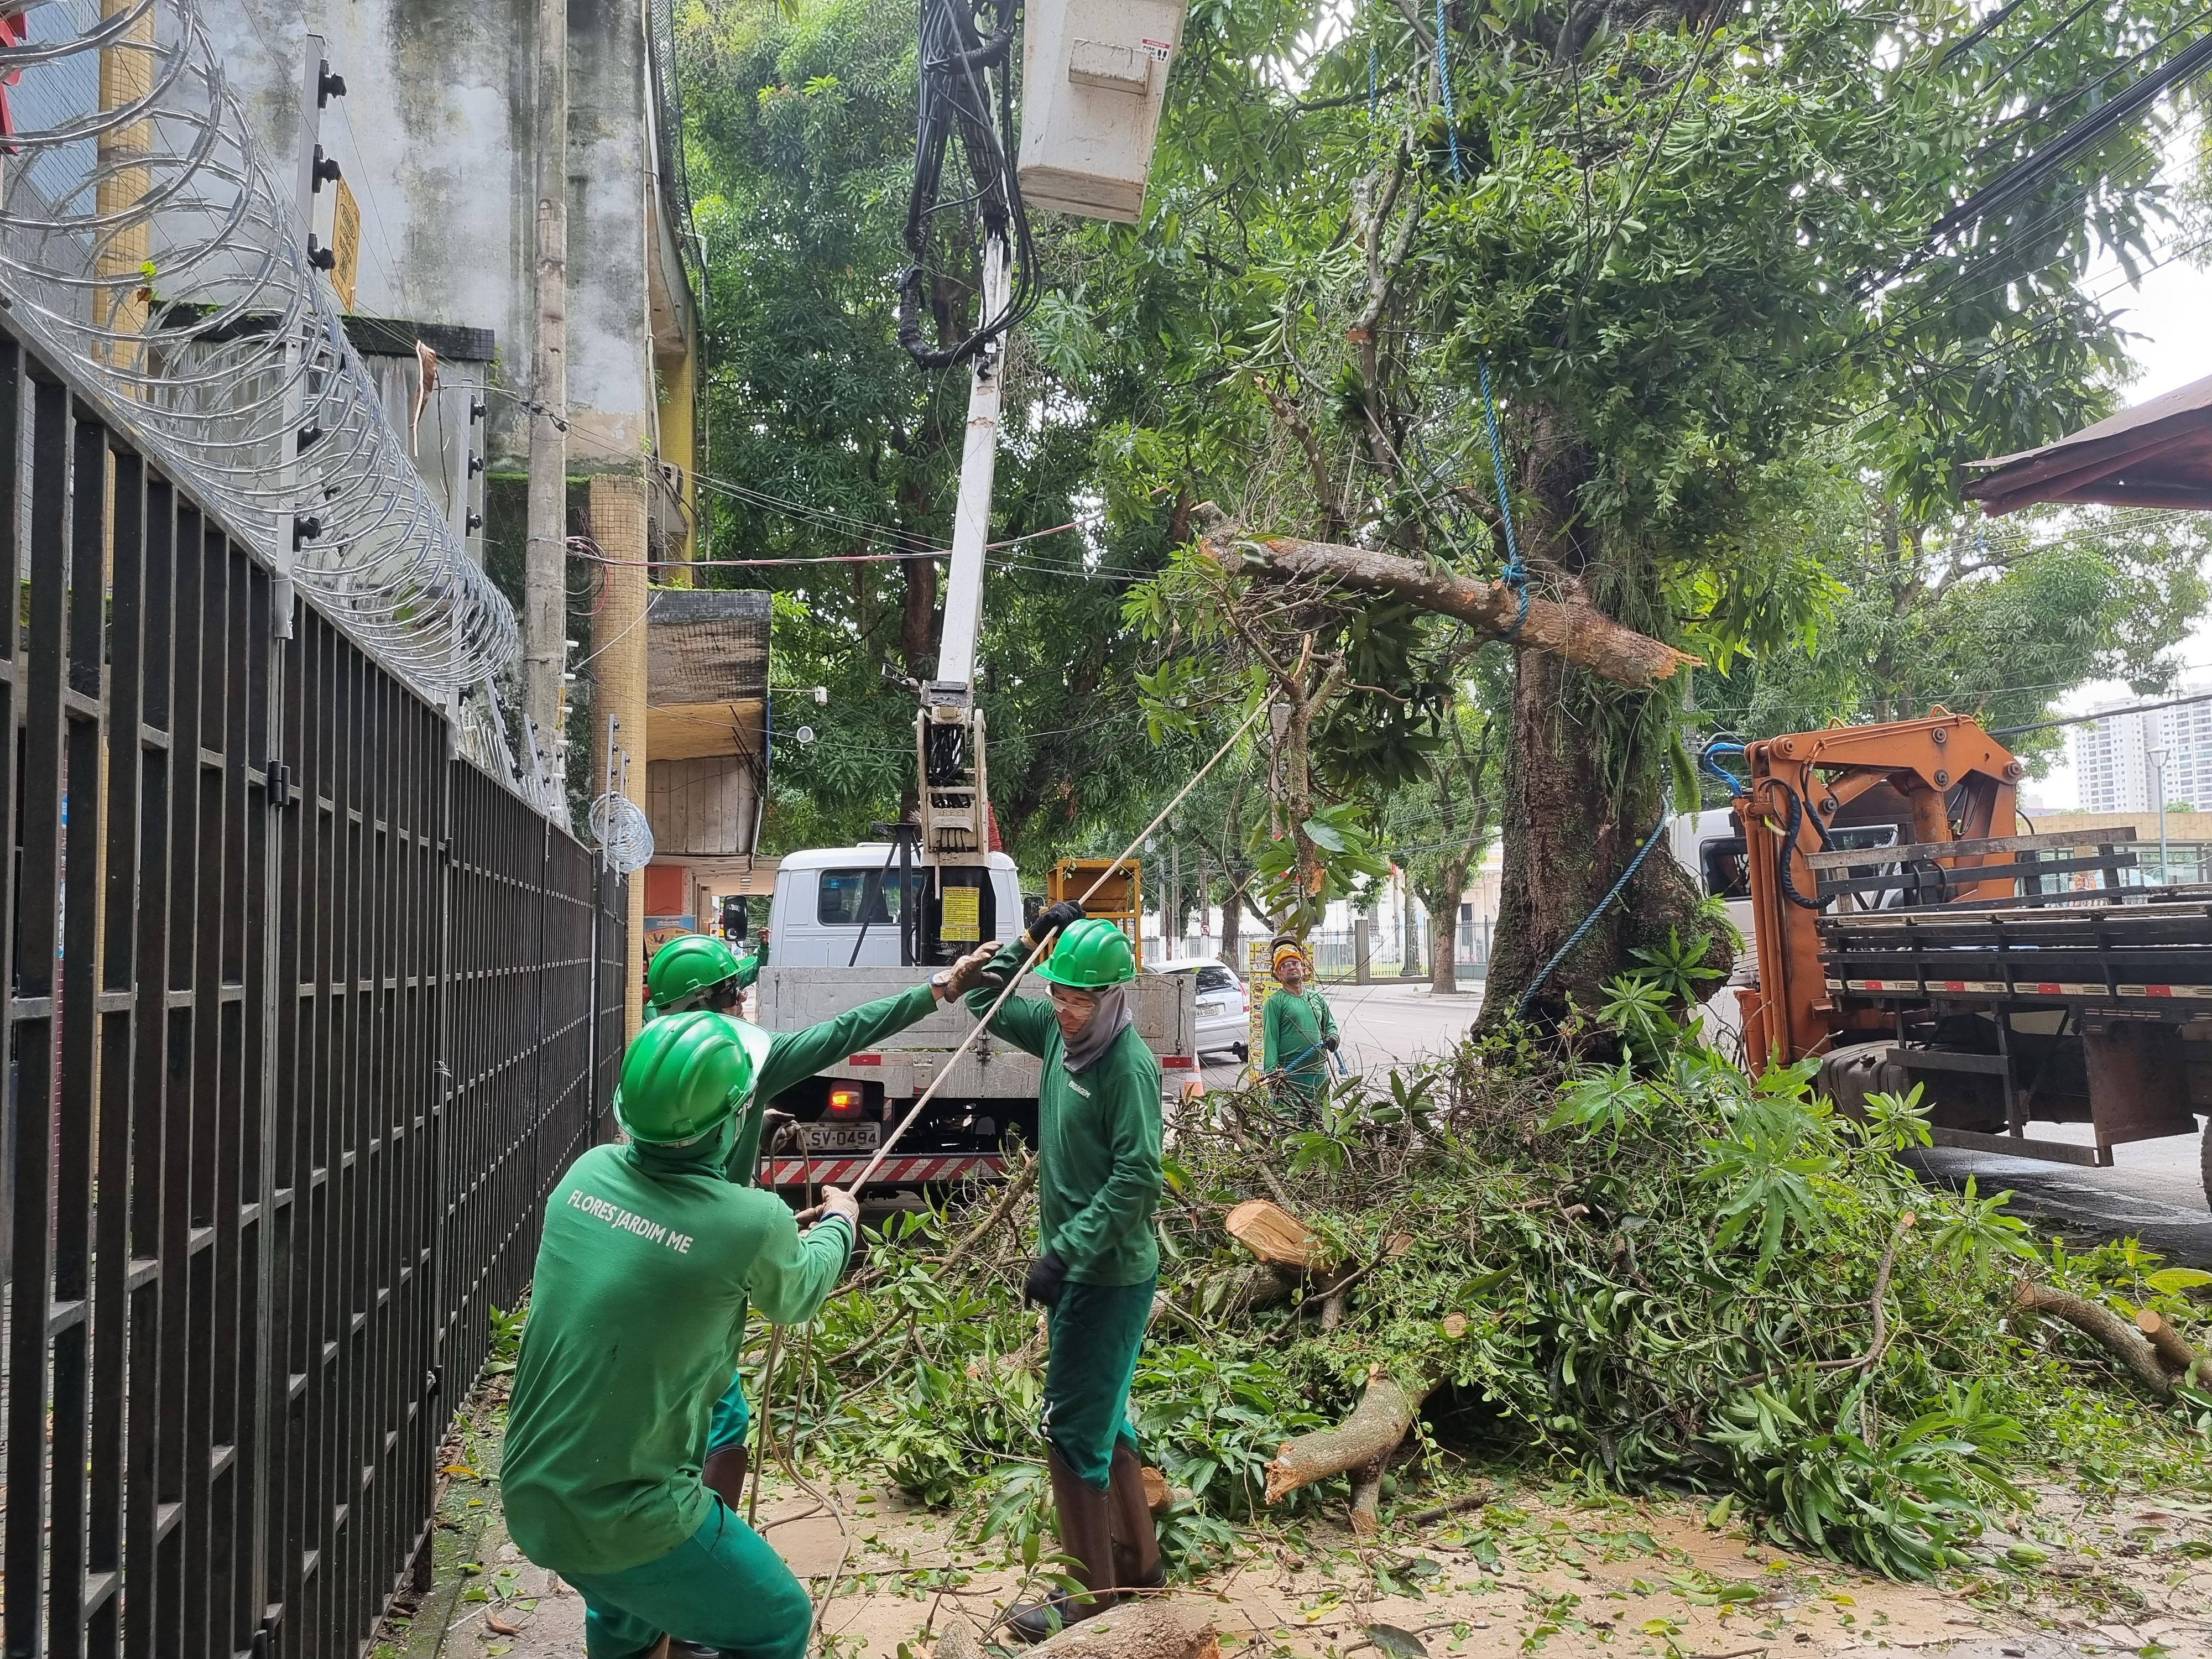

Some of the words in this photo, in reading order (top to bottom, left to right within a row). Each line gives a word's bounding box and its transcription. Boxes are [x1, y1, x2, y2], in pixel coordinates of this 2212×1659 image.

[567, 1189, 618, 1222] FLORES
[611, 1209, 667, 1244] JARDIM
[665, 1230, 693, 1254] ME
